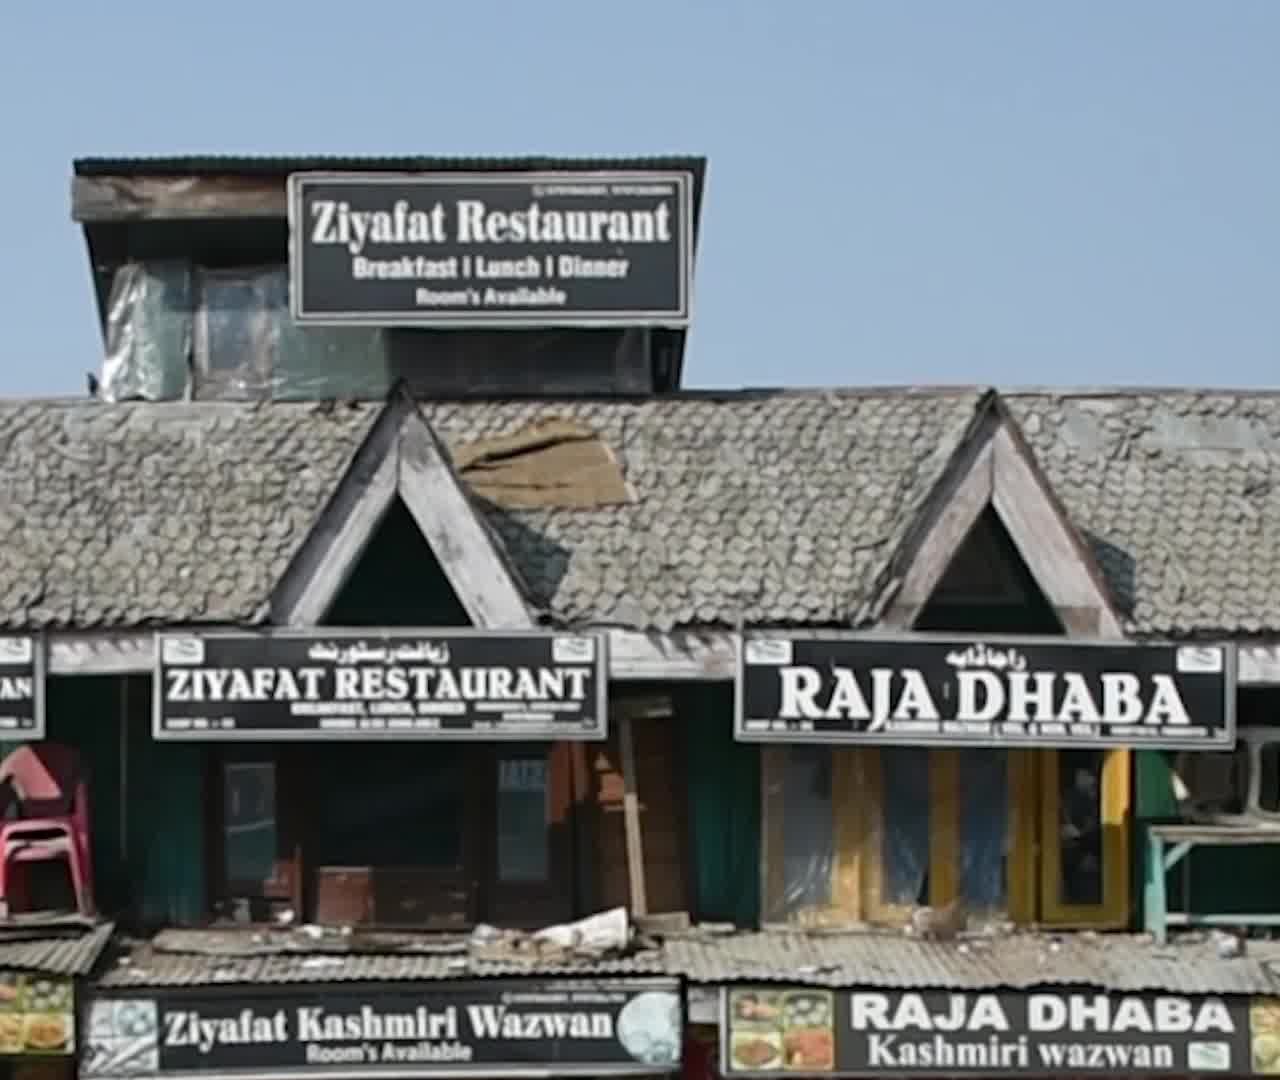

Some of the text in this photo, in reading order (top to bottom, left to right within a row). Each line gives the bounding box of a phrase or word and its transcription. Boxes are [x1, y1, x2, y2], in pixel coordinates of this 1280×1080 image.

[311, 199, 671, 254] Ziyafat Restaurant
[352, 256, 458, 279] Breakfast
[475, 255, 541, 278] Lunch
[558, 256, 630, 279] Dinner
[483, 288, 567, 306] Available
[166, 667, 591, 701] ZIYAFAT RESTAURANT
[779, 667, 1192, 731] RAJA DHABA
[164, 1003, 614, 1053] Ziyafat Kashmiri Wazwan
[851, 992, 1235, 1033] RAJA DHABA
[306, 1041, 473, 1063] Room's Available
[868, 1034, 1173, 1069] Kashmiri wazwan
